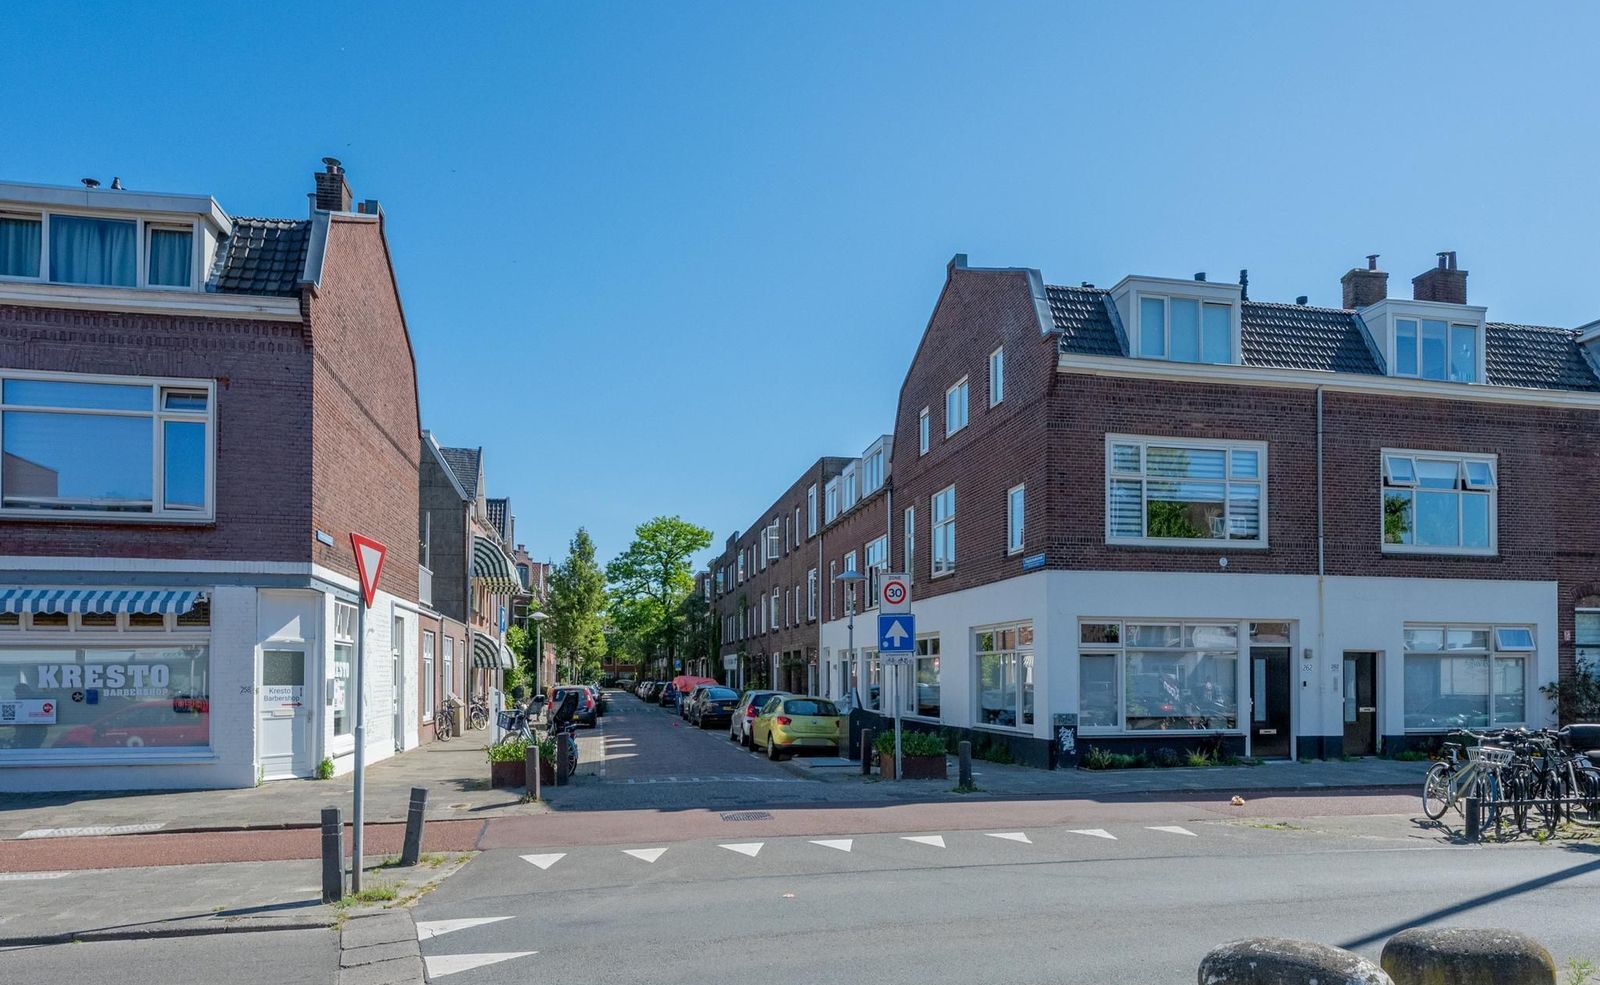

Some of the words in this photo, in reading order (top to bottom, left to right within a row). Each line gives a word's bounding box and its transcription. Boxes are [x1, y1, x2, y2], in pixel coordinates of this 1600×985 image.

[888, 588, 903, 598] 30
[38, 664, 170, 689] KRESTO
[103, 688, 169, 697] BARBERSHOP
